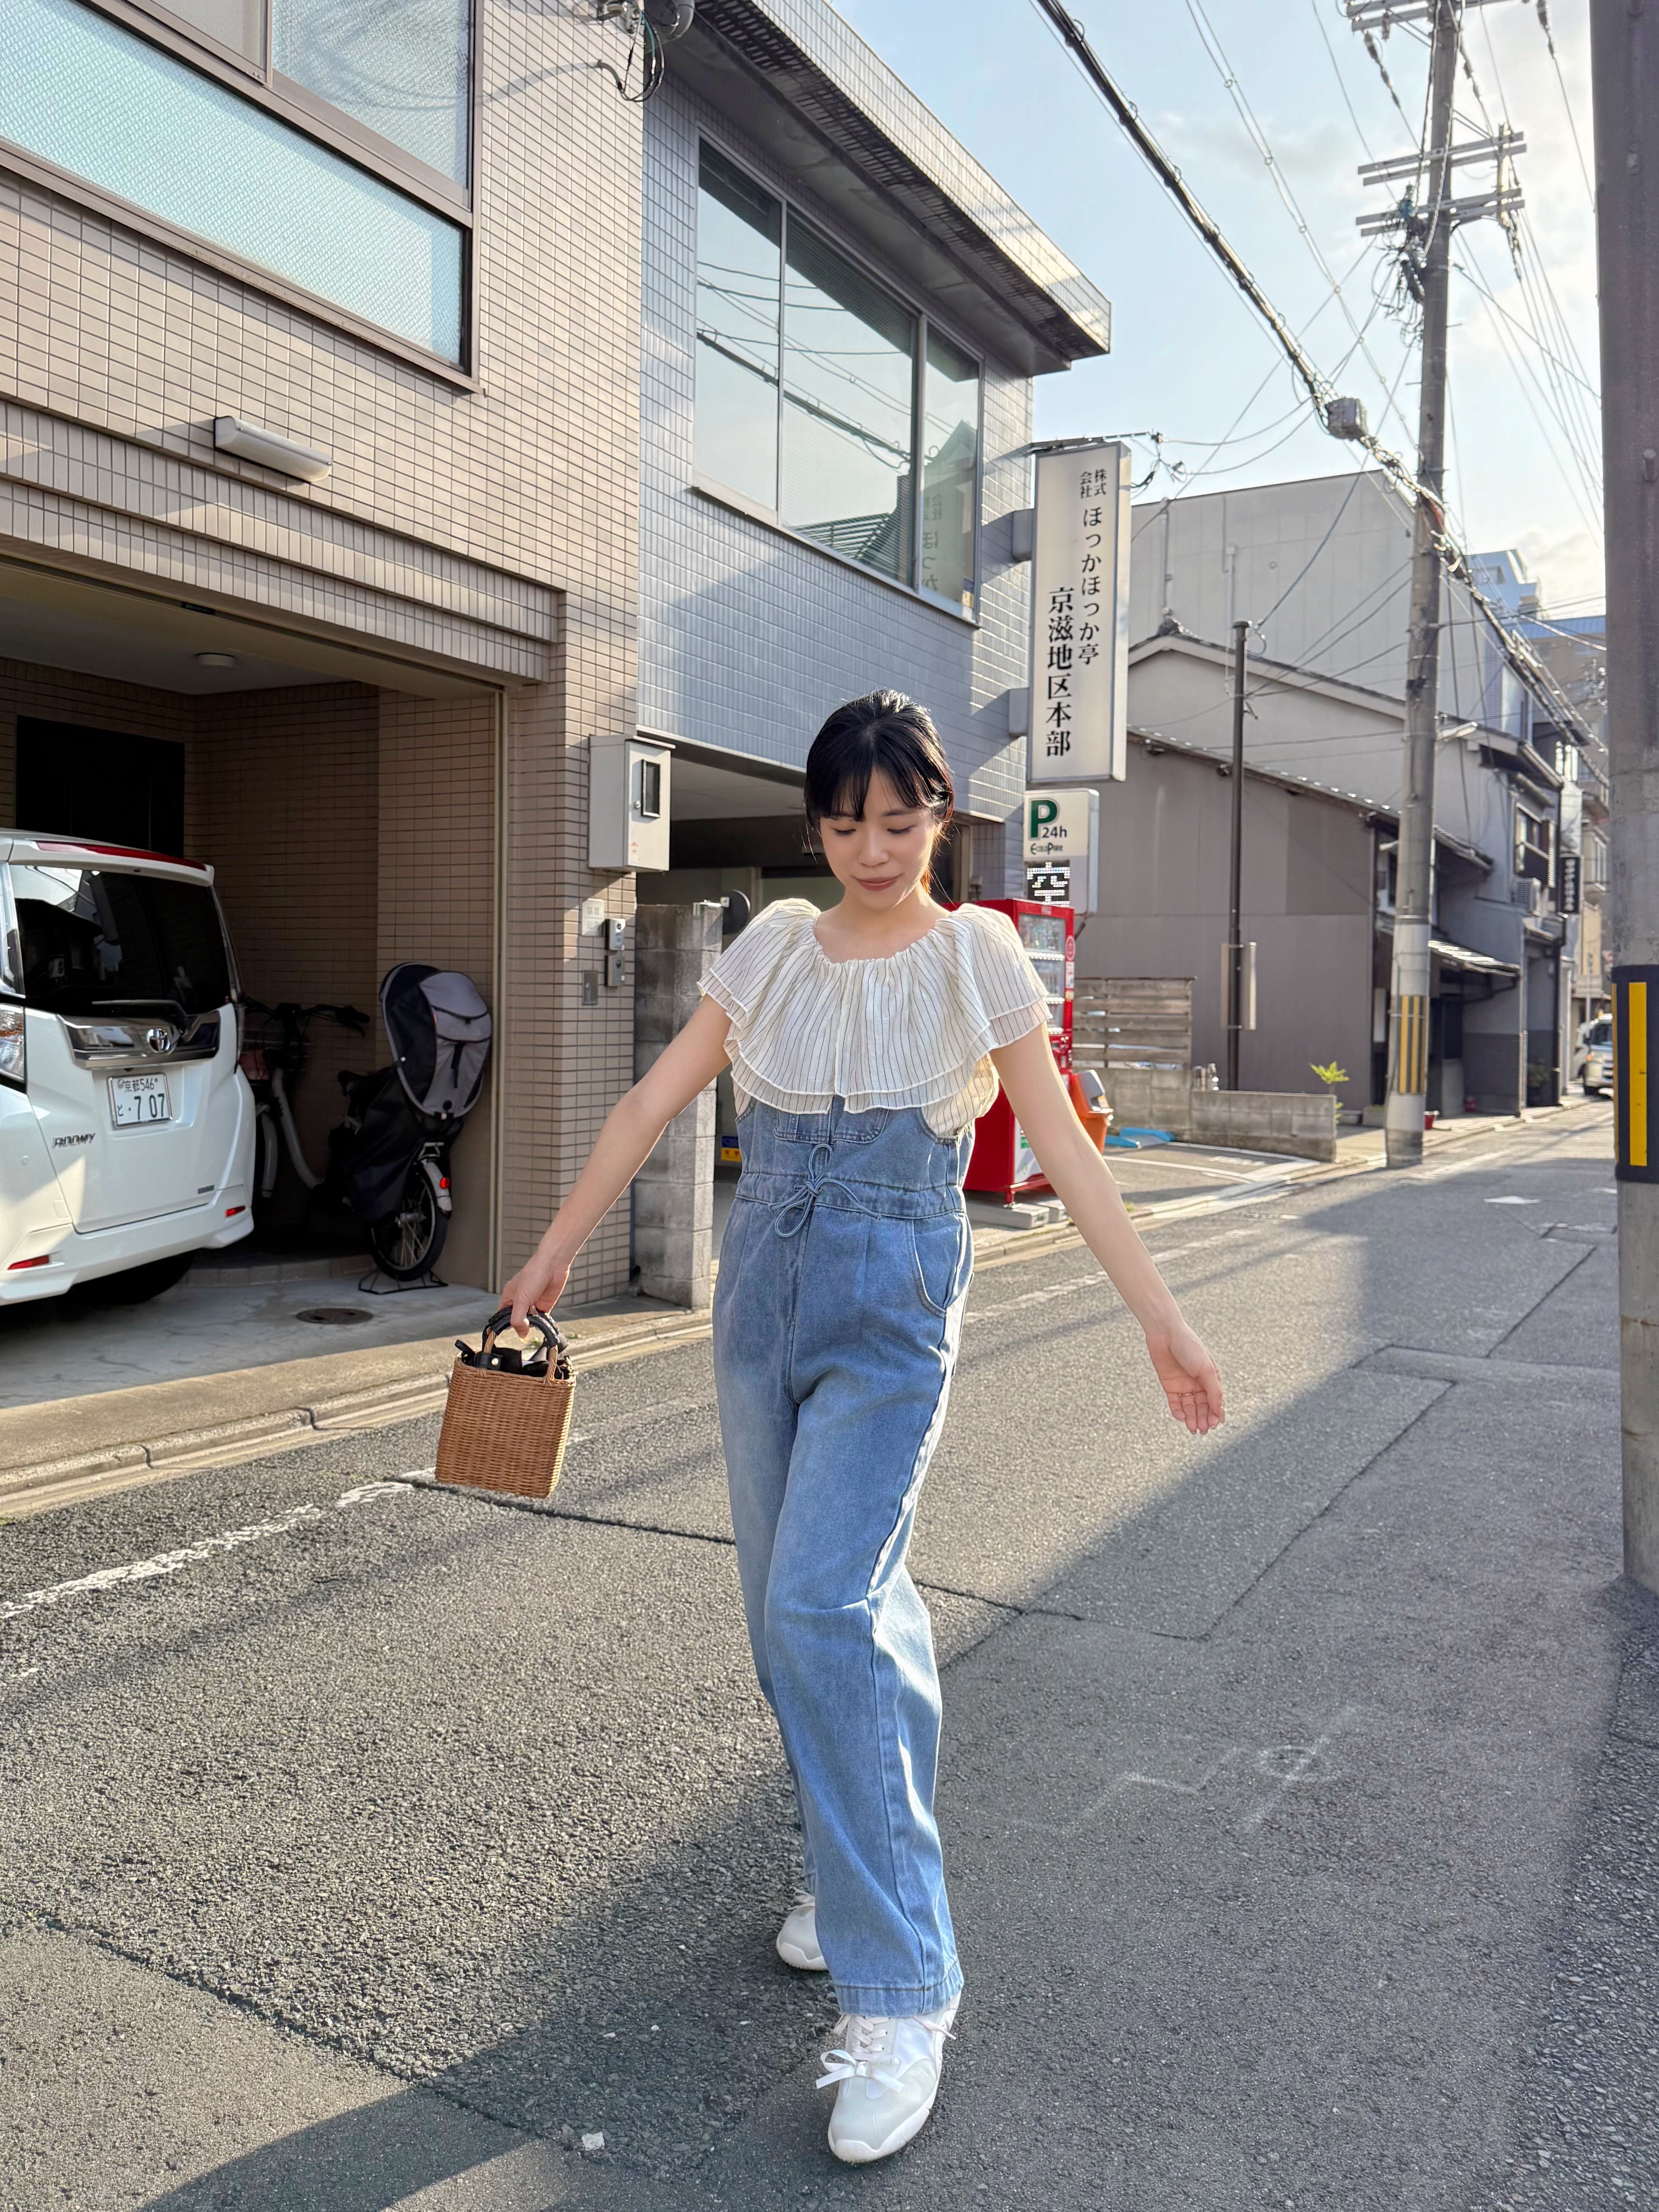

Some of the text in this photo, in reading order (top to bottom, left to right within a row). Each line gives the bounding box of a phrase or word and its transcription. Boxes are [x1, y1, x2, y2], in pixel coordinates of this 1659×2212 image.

[1045, 587, 1075, 757] 京滋地区本部
[1030, 799, 1058, 839] P
[1042, 825, 1068, 838] 24h
[1027, 861, 1071, 907] 空
